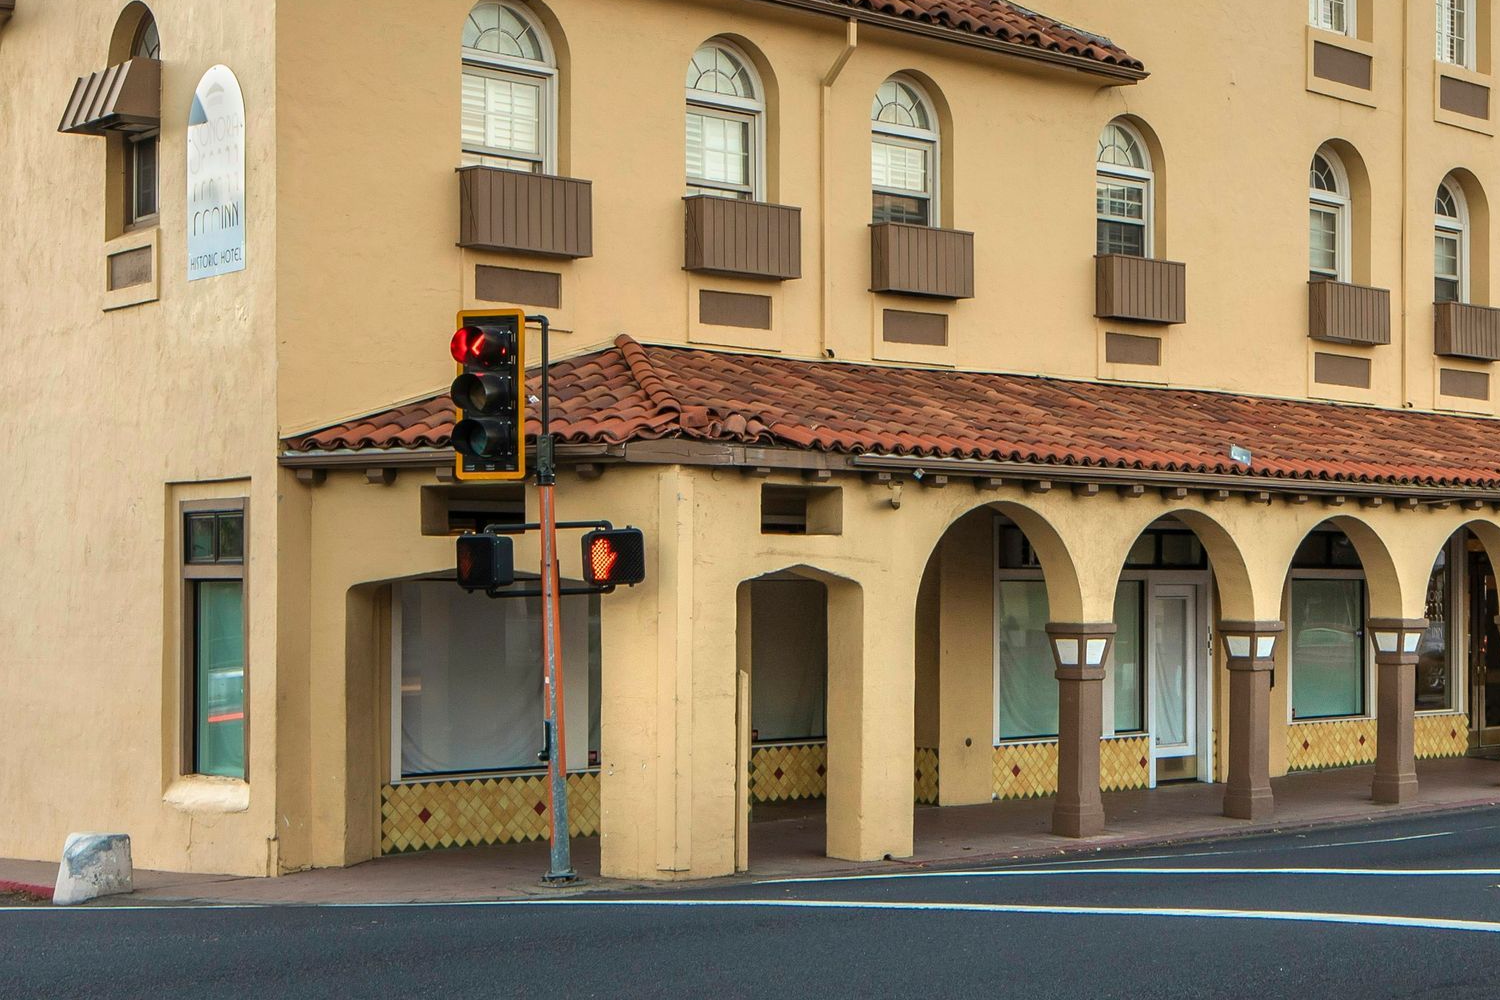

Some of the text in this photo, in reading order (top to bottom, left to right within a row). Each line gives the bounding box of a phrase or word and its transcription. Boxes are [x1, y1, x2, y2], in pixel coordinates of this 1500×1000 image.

[221, 200, 240, 231] INN
[190, 246, 242, 271] HISTORIC HOTEL
